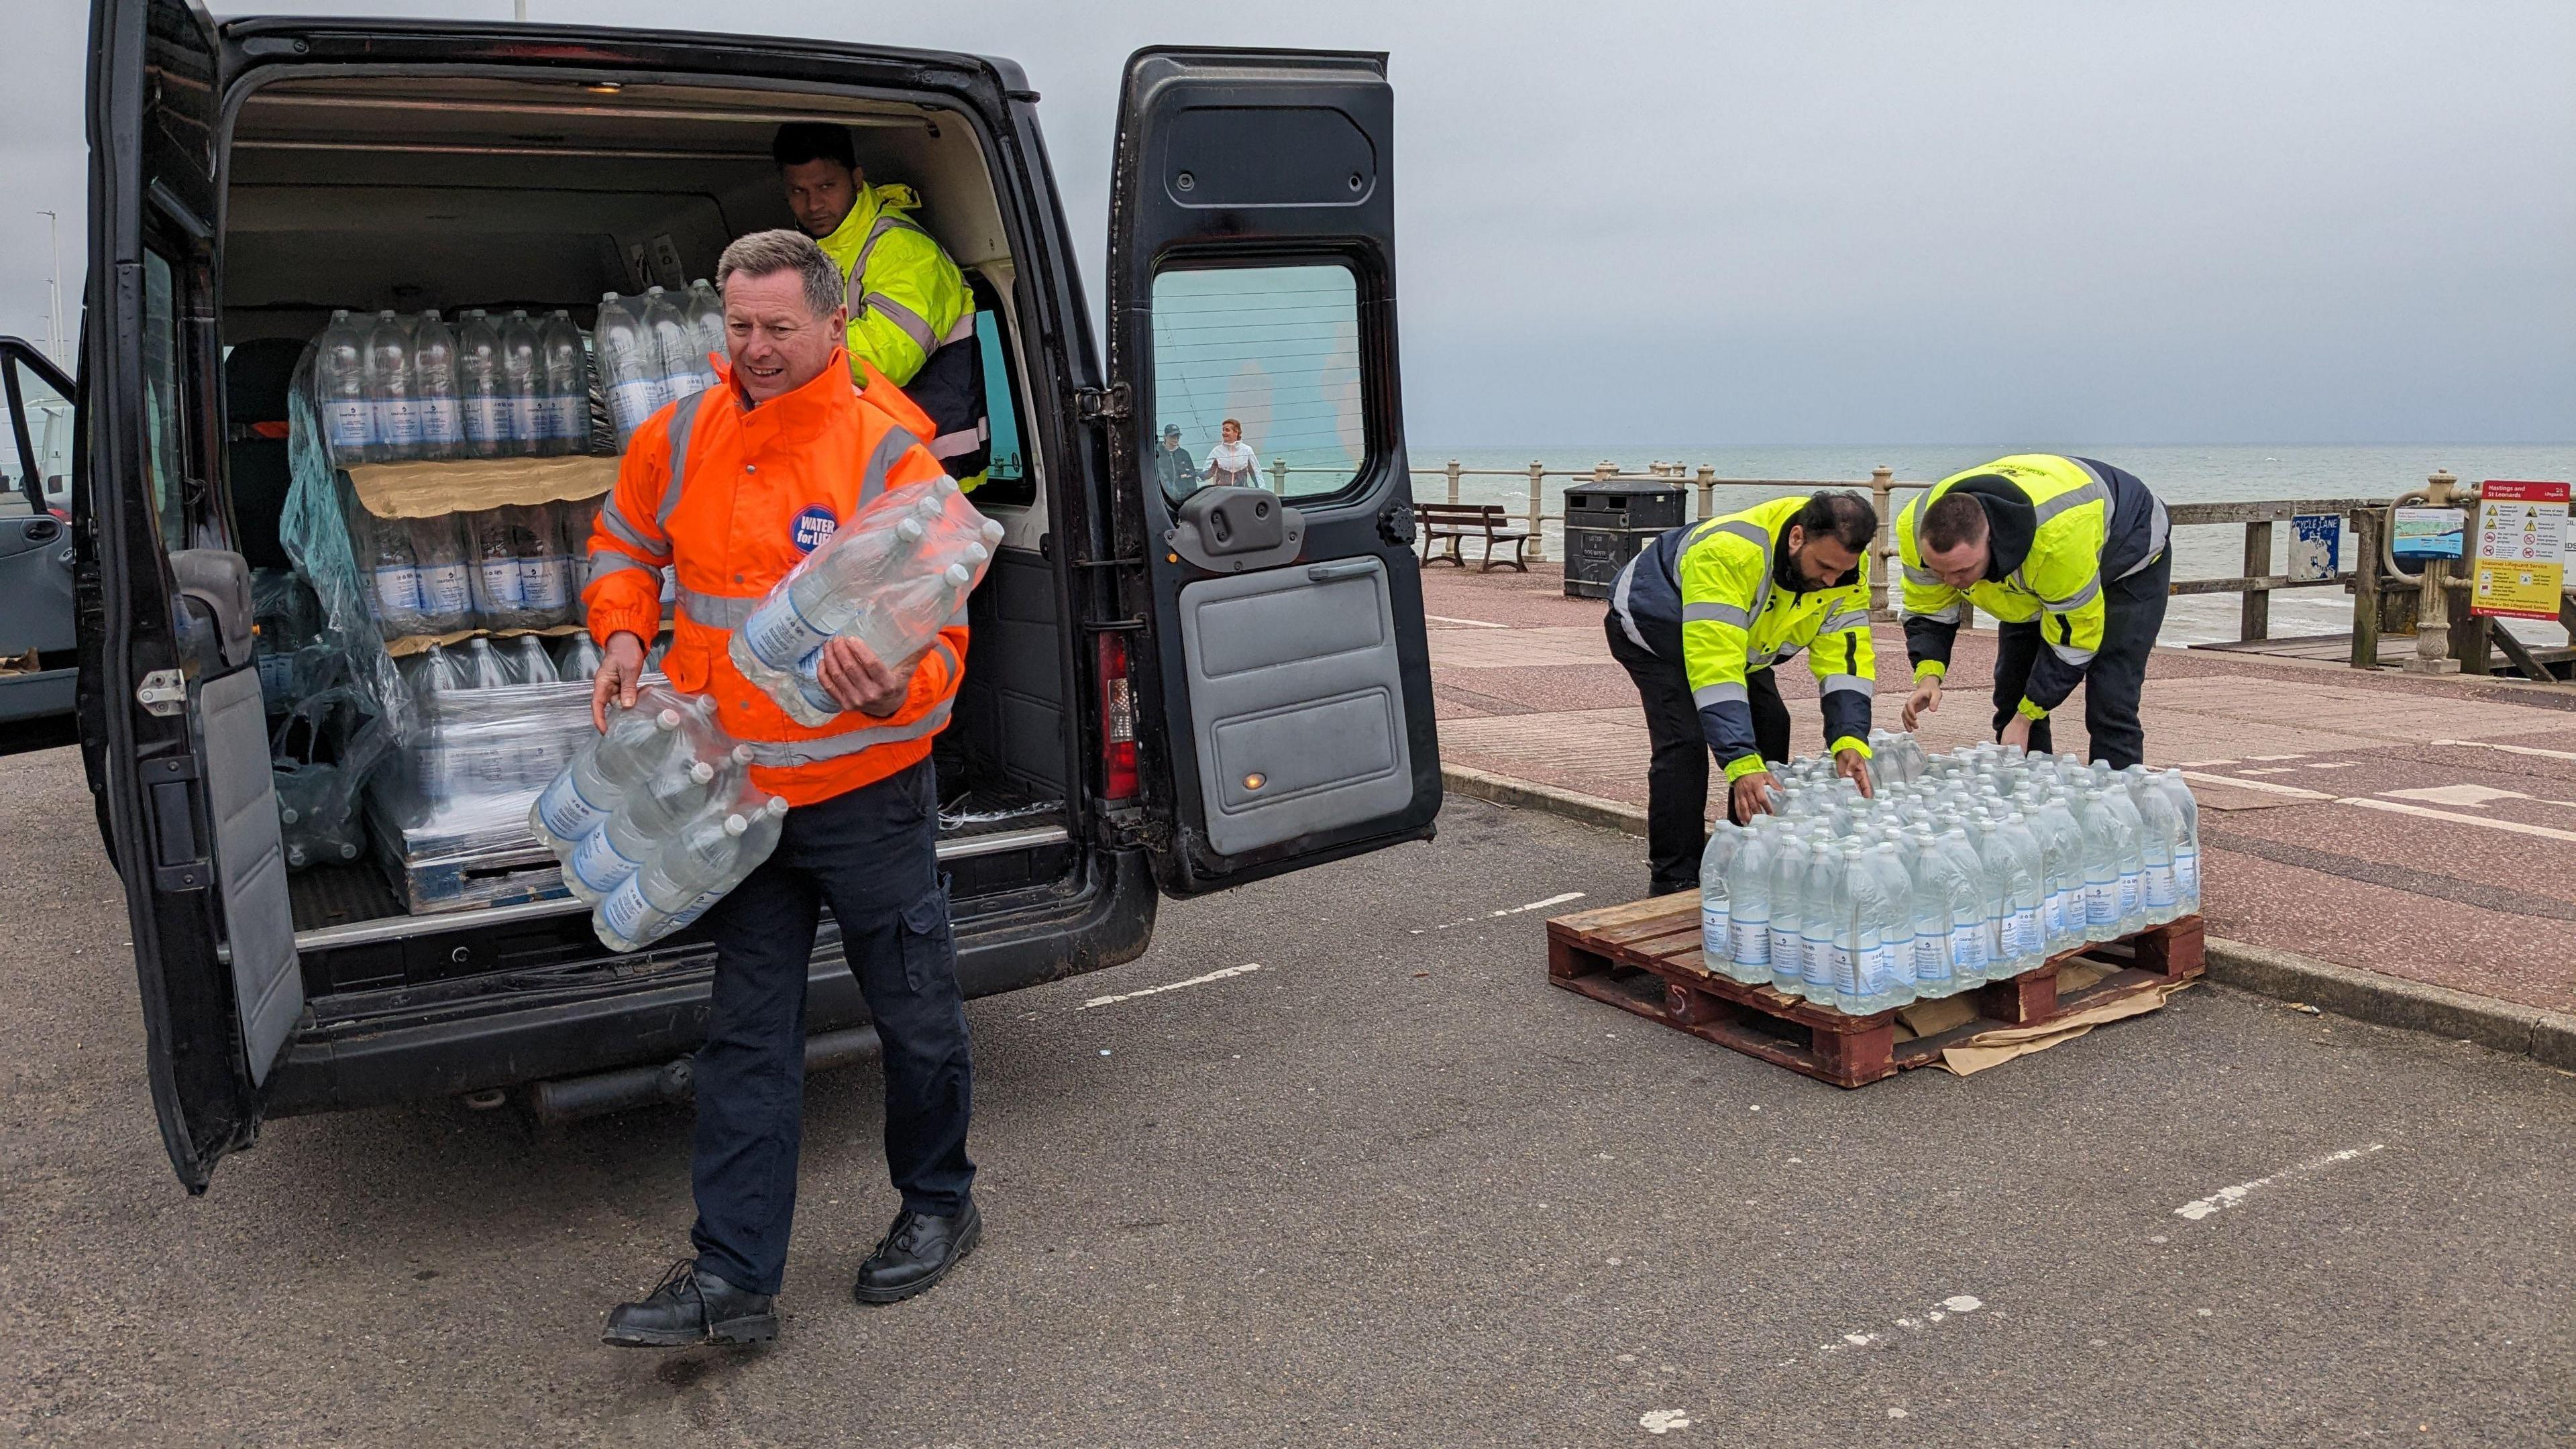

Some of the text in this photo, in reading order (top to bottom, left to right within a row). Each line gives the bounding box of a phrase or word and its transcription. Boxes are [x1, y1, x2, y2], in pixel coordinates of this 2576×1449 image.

[801, 516, 835, 533] WATER
[2295, 519, 2338, 529] CYCLE LANE
[797, 530, 813, 544] for
